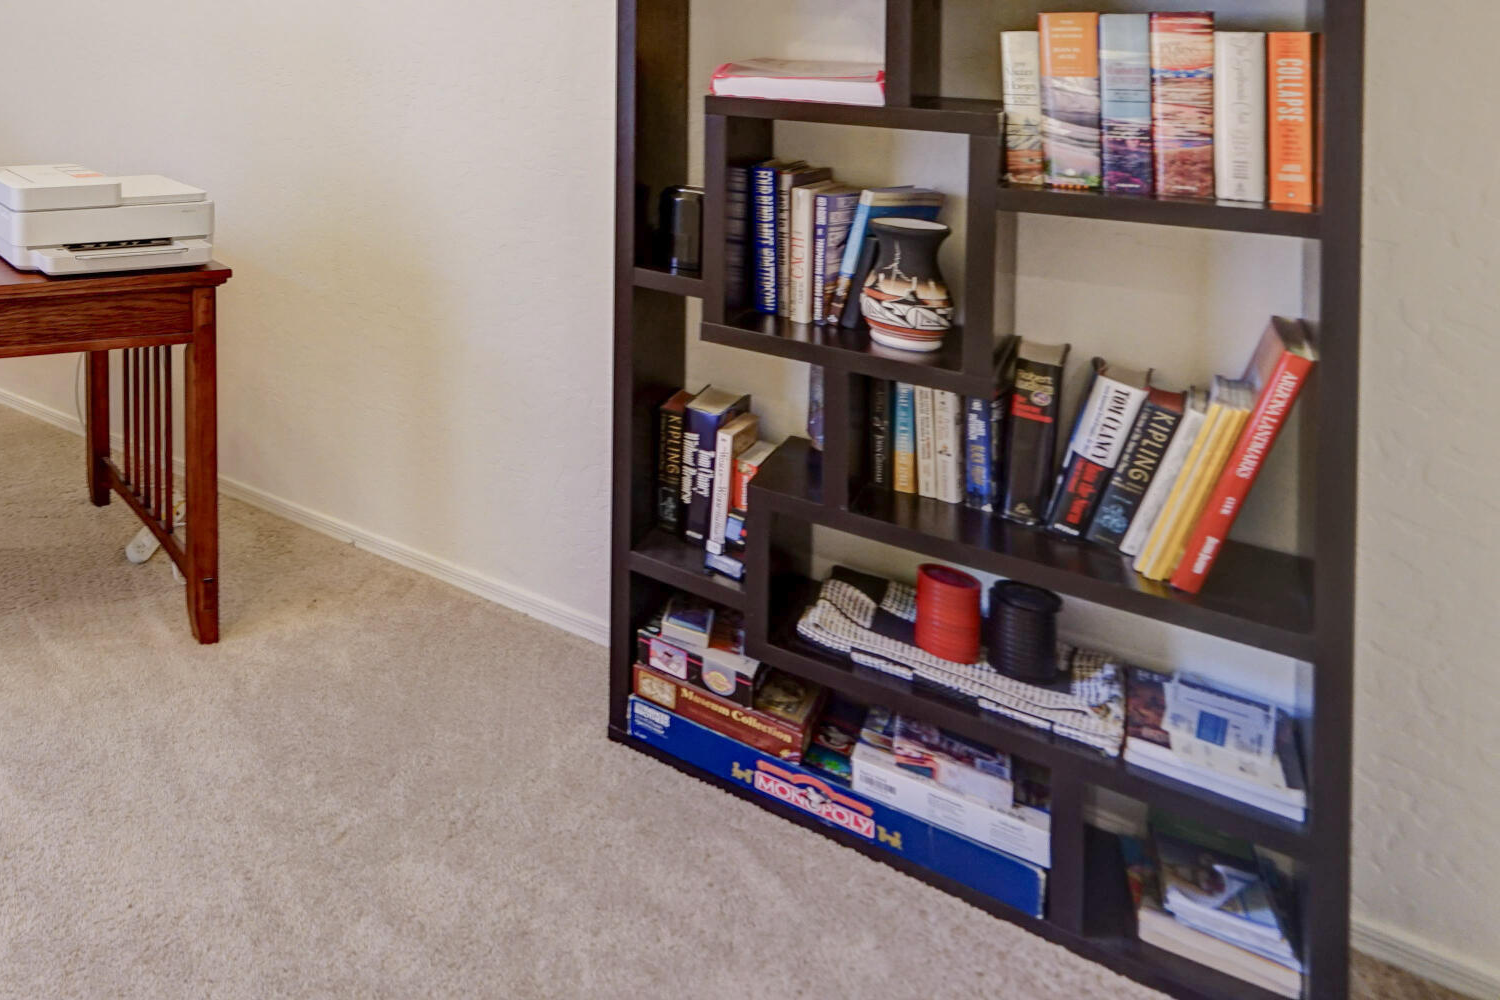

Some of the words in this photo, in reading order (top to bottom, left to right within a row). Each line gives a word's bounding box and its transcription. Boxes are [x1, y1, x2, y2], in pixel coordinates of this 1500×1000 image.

[1276, 58, 1305, 122] COLLAPSE
[1108, 389, 1130, 414] TOM
[1266, 371, 1299, 419] ARIZONA
[666, 415, 682, 474] KIPLING
[1092, 416, 1123, 460] CLANCY
[1128, 411, 1176, 483] KIPLING
[1235, 412, 1280, 479] LANDMARKS
[681, 687, 731, 716] Museum
[731, 710, 793, 744] Collection
[757, 774, 875, 838] MONOPOLY
